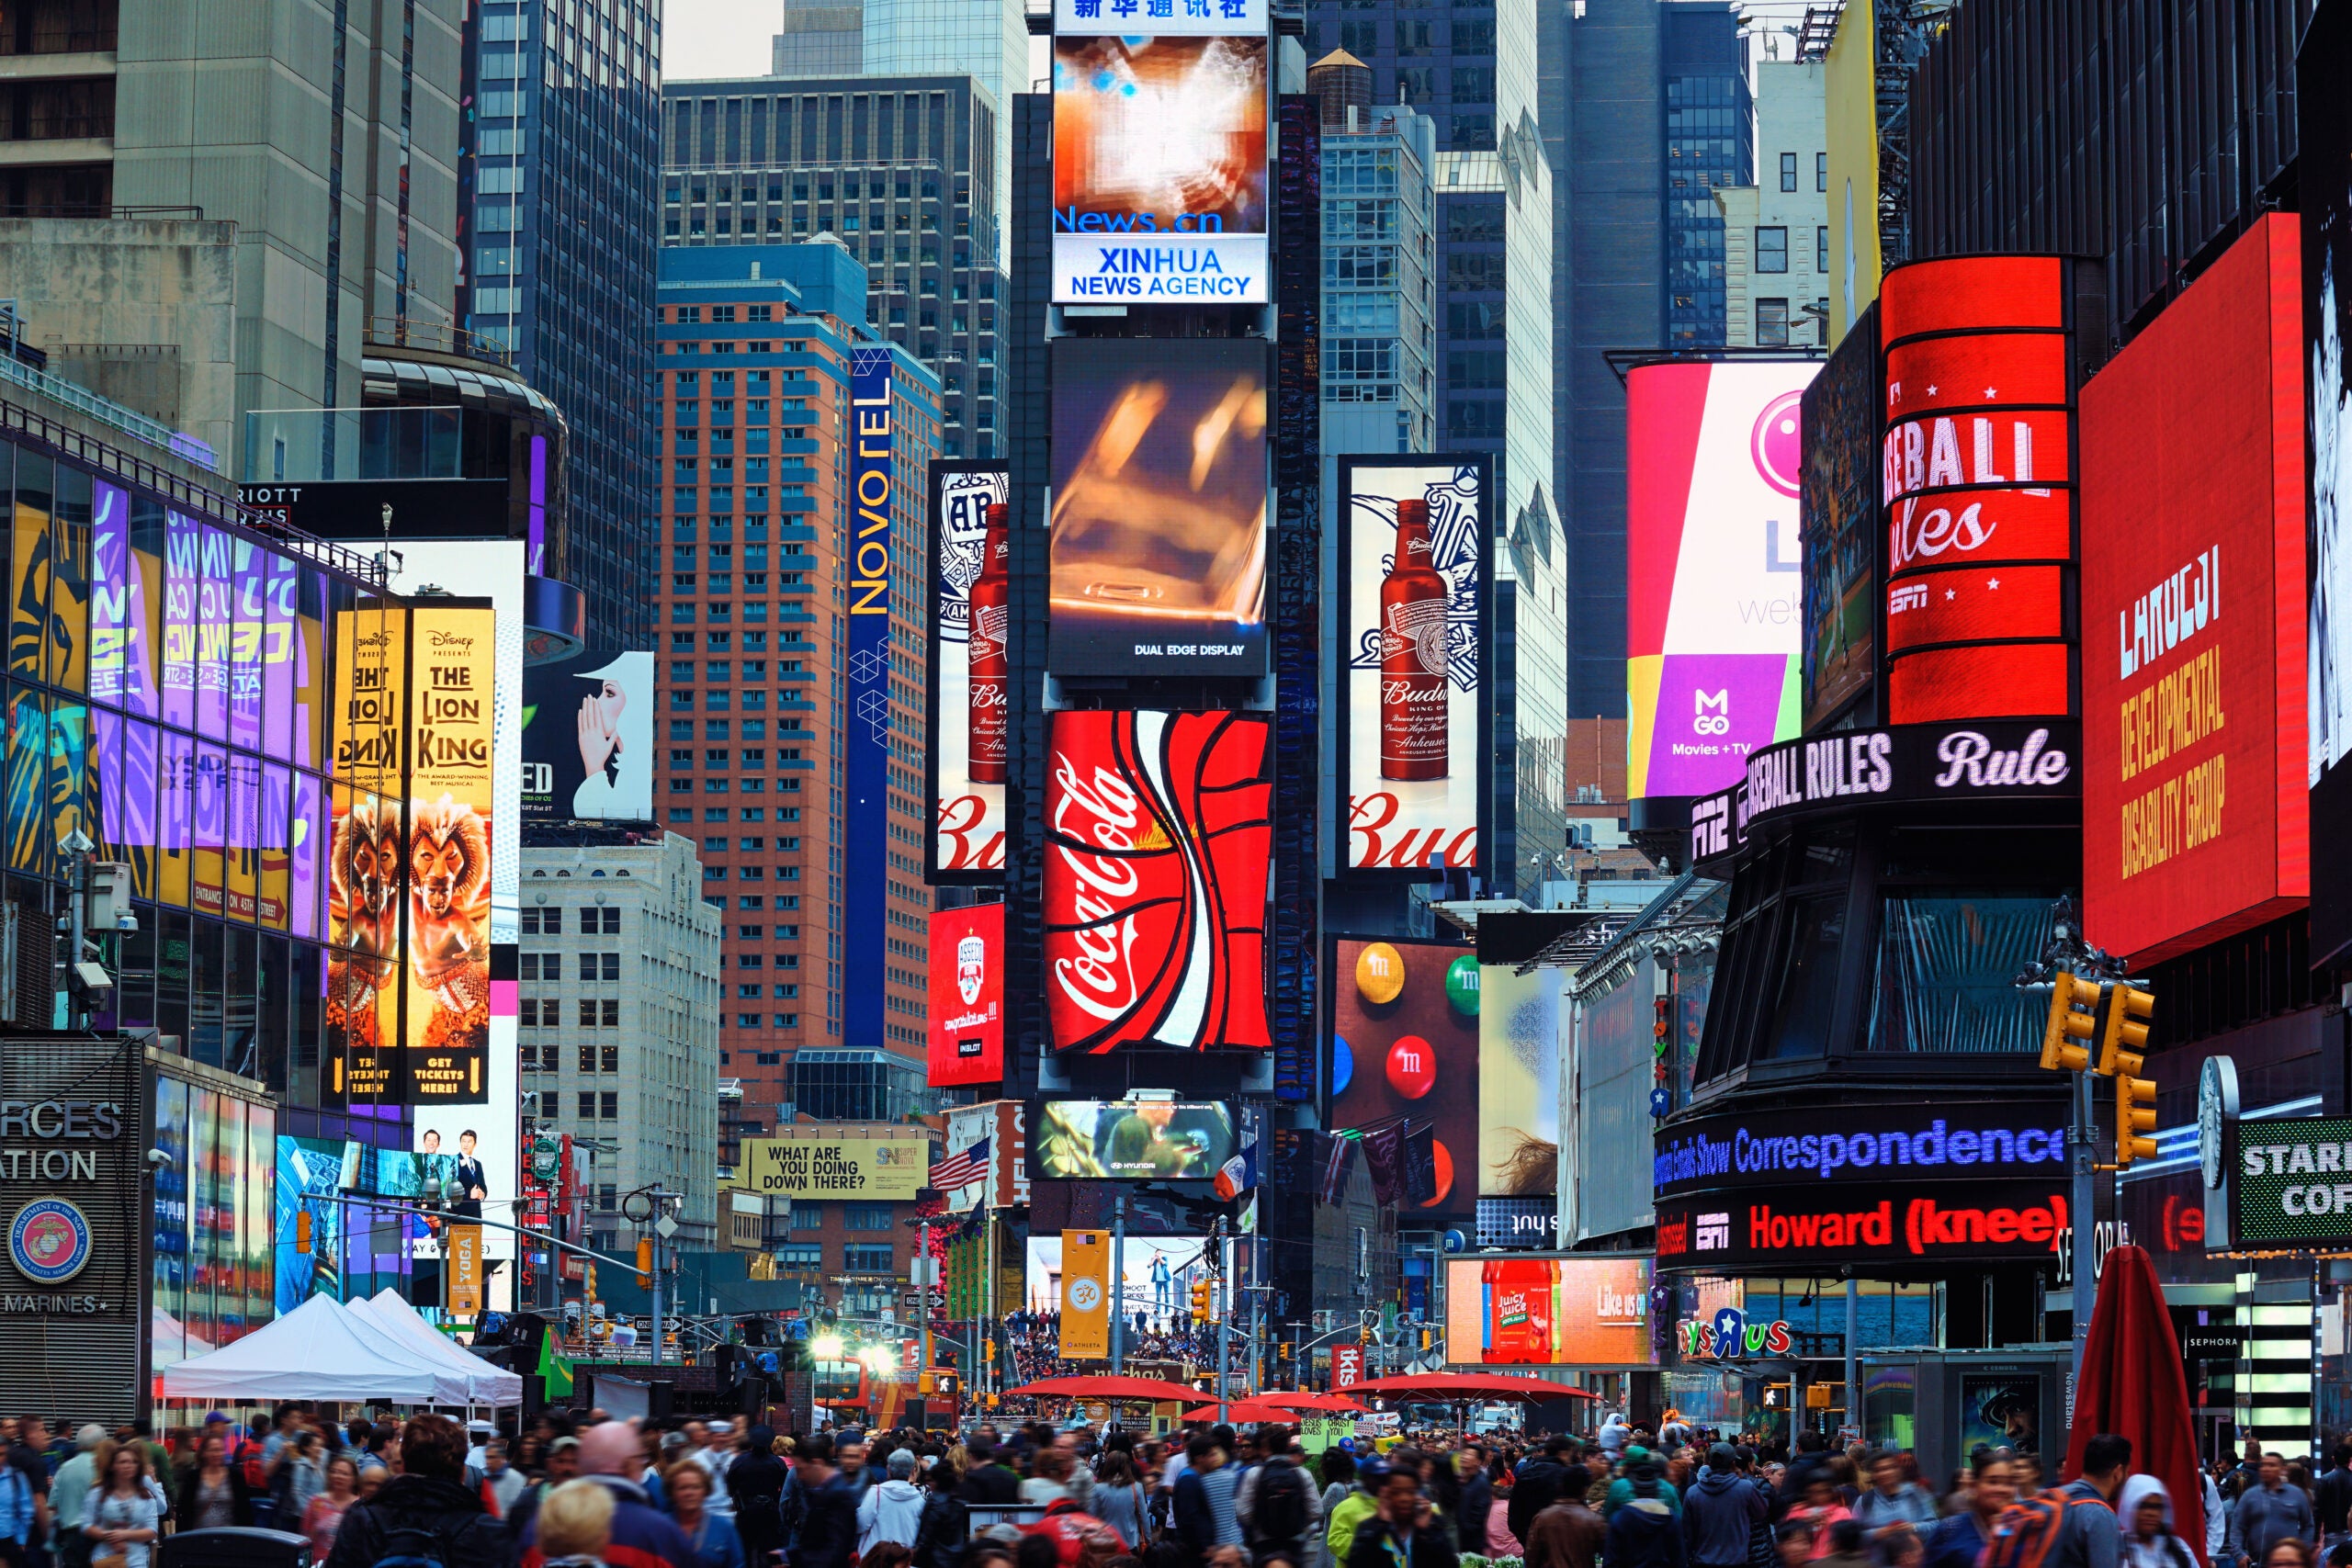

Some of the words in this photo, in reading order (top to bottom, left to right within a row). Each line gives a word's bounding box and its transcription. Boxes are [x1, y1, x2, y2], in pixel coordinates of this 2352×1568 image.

[1075, 0, 1246, 18] 新华通讯社
[1054, 206, 1222, 232] News.cn
[1099, 248, 1223, 273] XINHUA
[1072, 276, 1141, 295] NEWS
[1148, 276, 1251, 295] AGENCY
[850, 378, 891, 615] NOVOTEL
[425, 630, 474, 650] Disney
[1135, 645, 1163, 655] DUAL
[1167, 645, 1196, 655] EDGE
[1200, 645, 1245, 656] DISPLAY
[430, 667, 470, 685] THE
[423, 691, 479, 725] LION
[2121, 644, 2224, 783] DEVELOPMENTAL
[1693, 716, 1730, 736] GO
[418, 728, 487, 769] KING
[1672, 742, 1719, 756] Movies
[1732, 743, 1751, 755] TV
[1935, 728, 2070, 788] Rule
[1806, 733, 1893, 801] RULES
[2122, 775, 2182, 880] DISABILITY
[2185, 753, 2225, 851] GROUP
[1055, 750, 1139, 1021] Coca-Cola
[196, 886, 222, 904] ENTRANCE
[230, 894, 238, 908] ON
[241, 896, 254, 912] 45TH
[260, 901, 277, 919] STREET
[427, 1058, 452, 1067] GET
[414, 1070, 465, 1080] TICKETS
[421, 1083, 458, 1093] HERE!
[768, 1147, 811, 1161] WHAT
[815, 1147, 842, 1161] ARE
[1697, 1133, 1731, 1178] Show
[779, 1161, 808, 1176] YOU
[812, 1161, 858, 1176] DOING
[763, 1175, 808, 1190] DOWN
[813, 1175, 865, 1189] THERE?
[15, 1203, 51, 1238] DEPARTMENT
[73, 1215, 85, 1237] NAVY
[1749, 1201, 1892, 1247] Howard
[1905, 1195, 2068, 1255] (knee)
[459, 1236, 472, 1282] YOGA
[5, 1295, 96, 1313] MARINES
[1498, 1292, 1525, 1308] Juicy
[1597, 1285, 1623, 1316] Like
[1624, 1294, 1635, 1316] us
[1636, 1293, 1645, 1316] on
[1499, 1303, 1527, 1318] Juice
[2190, 1338, 2238, 1347] SEPHORA
[1340, 1348, 1358, 1387] tkts
[1301, 1418, 1321, 1427] JESUS
[1328, 1418, 1351, 1427] CHRIST
[1329, 1427, 1343, 1436] YOU
